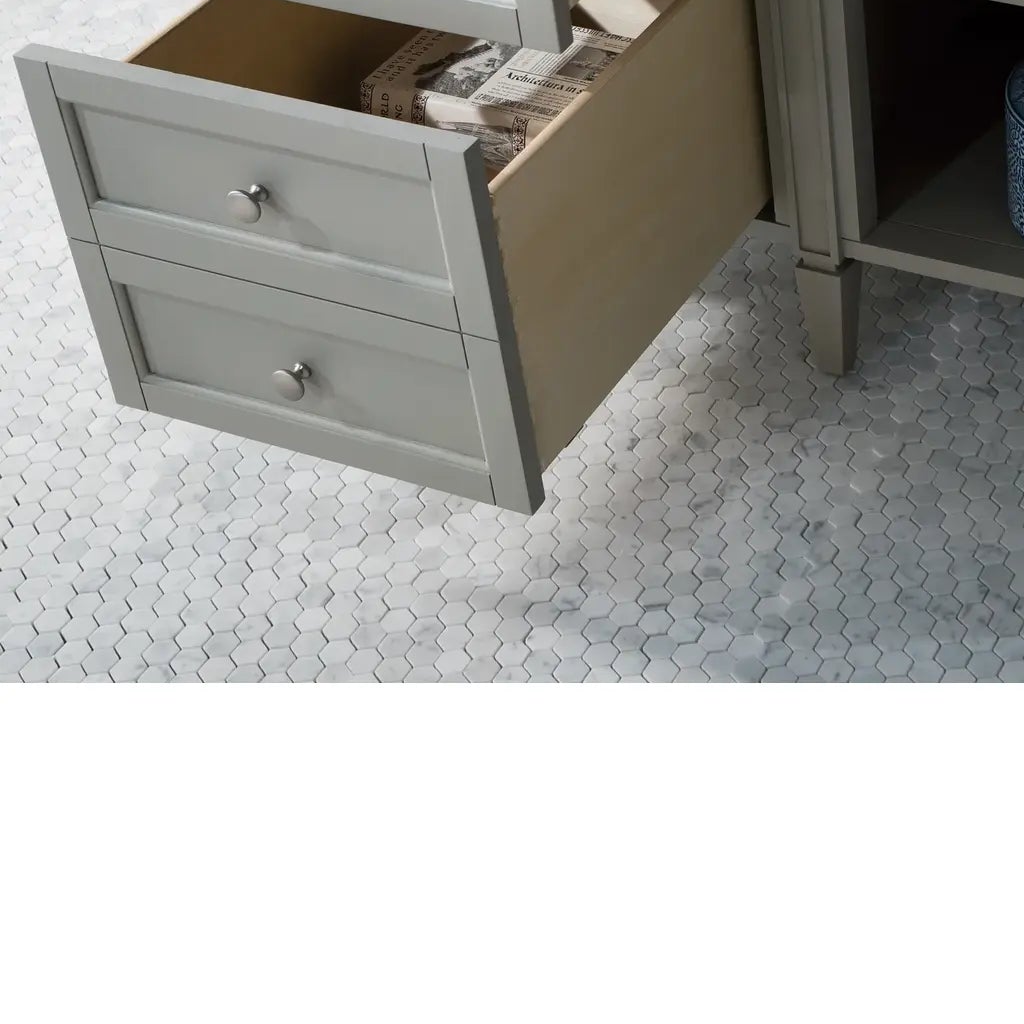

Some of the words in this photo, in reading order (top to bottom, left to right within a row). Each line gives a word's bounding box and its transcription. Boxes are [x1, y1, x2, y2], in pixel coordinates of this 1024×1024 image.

[377, 55, 405, 74] have
[404, 35, 428, 54] seen
[386, 65, 406, 82] and
[411, 42, 434, 57] has
[505, 71, 564, 92] Architettura
[565, 85, 577, 94] in
[380, 92, 390, 118] RLD
